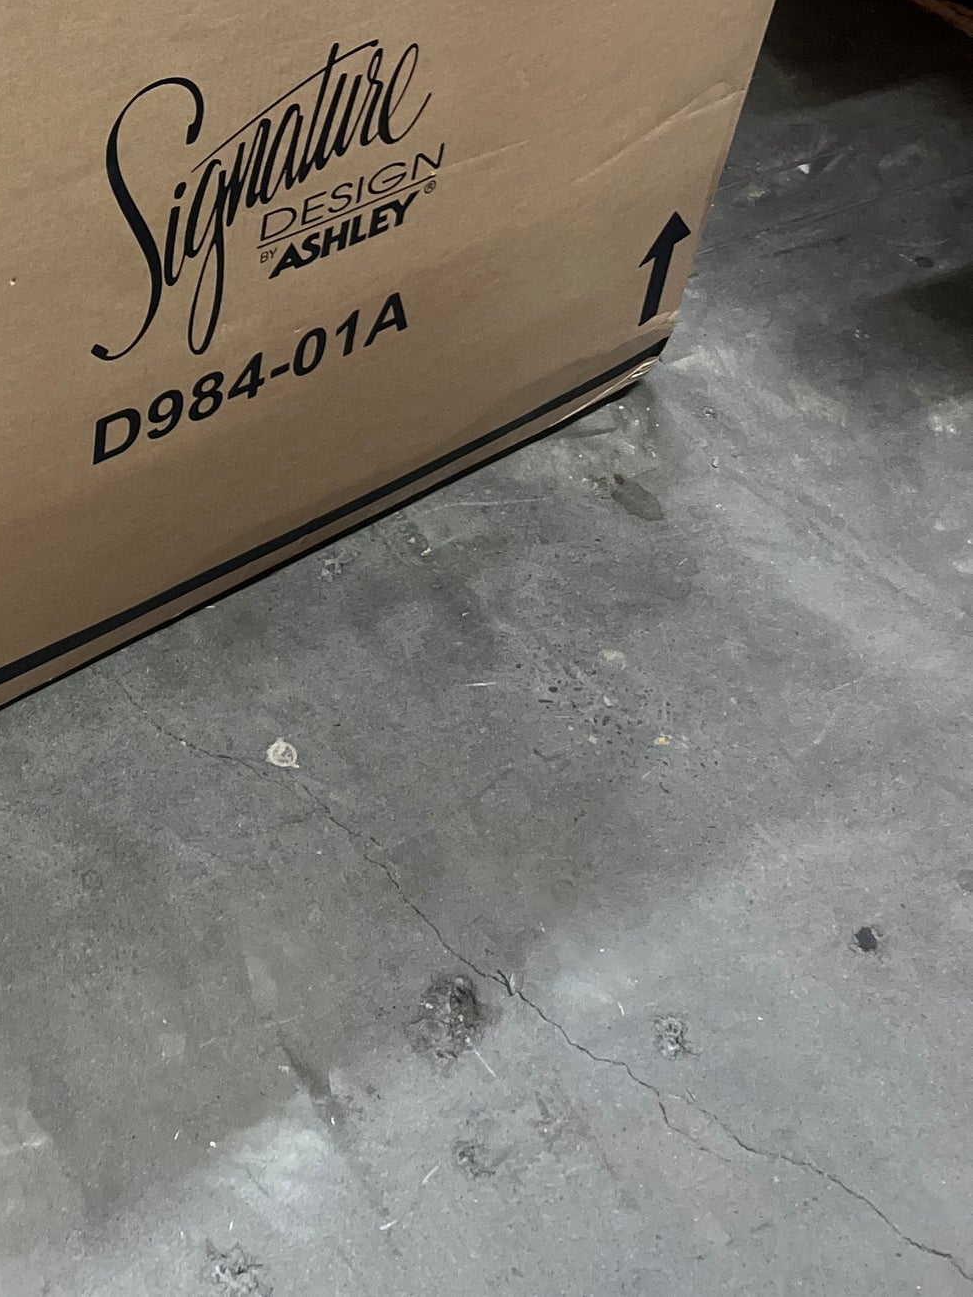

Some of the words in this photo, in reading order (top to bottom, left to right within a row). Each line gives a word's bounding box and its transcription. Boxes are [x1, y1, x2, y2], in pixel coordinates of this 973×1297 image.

[90, 39, 433, 361] Signature
[259, 142, 445, 242] DESIGN
[267, 189, 421, 280] ASHLEY
[259, 246, 278, 264] BY
[91, 292, 409, 465] D984-01A
